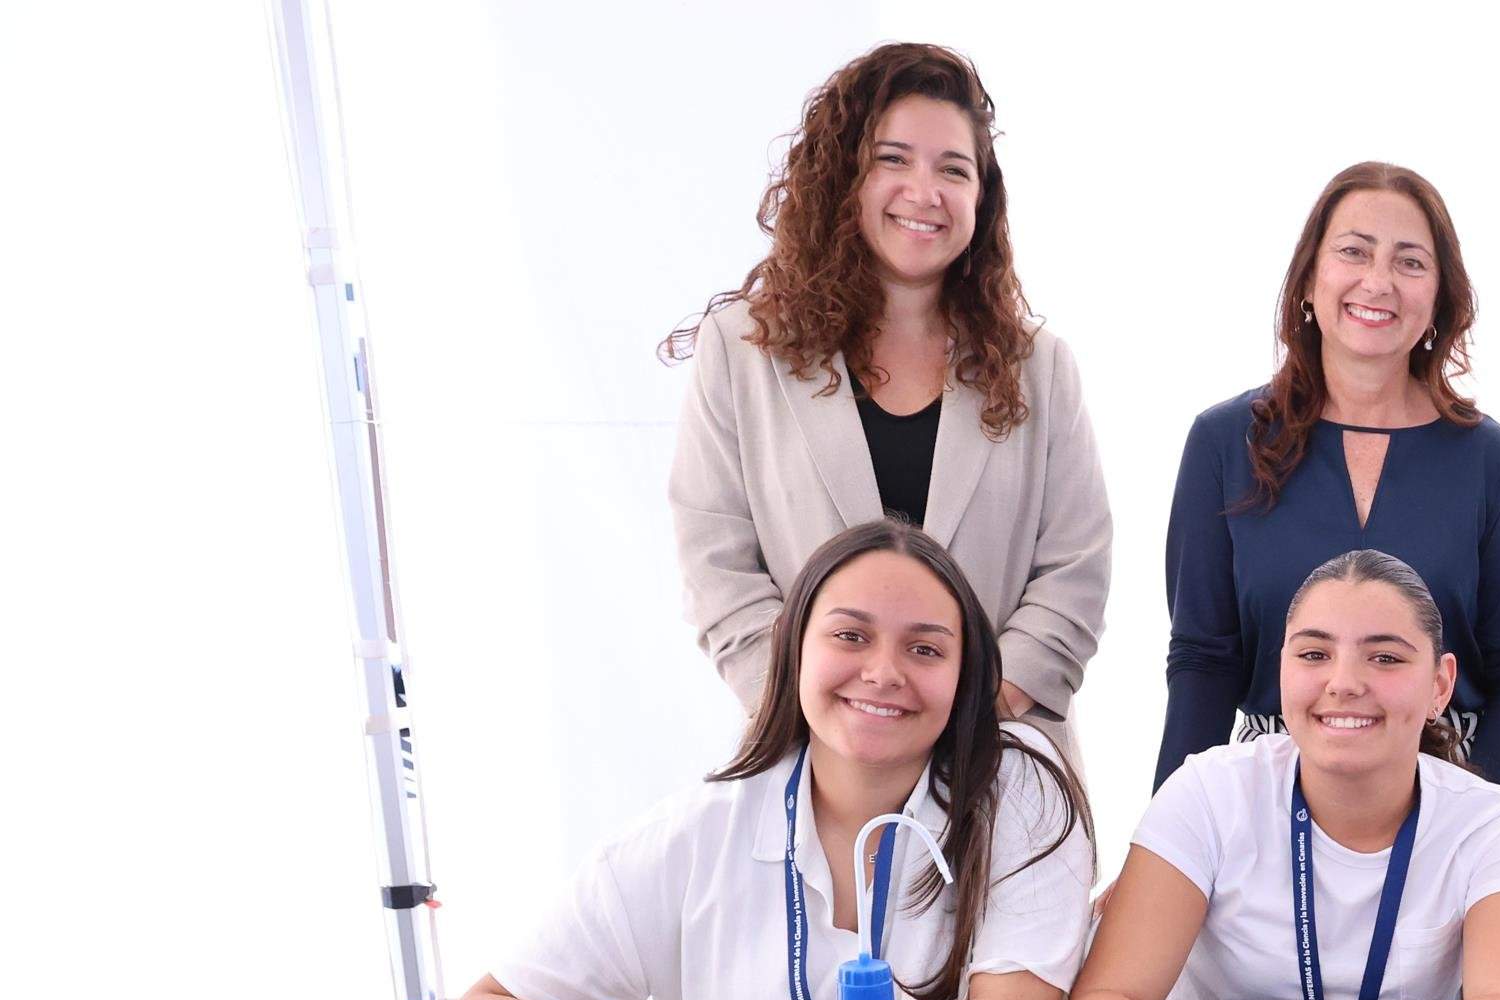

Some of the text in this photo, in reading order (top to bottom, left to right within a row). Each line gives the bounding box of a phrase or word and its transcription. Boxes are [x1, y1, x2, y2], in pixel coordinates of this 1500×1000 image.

[1297, 832, 1306, 861] Canarias
[1300, 862, 1306, 871] en
[1298, 873, 1308, 910] Innovación
[793, 901, 801, 909] la
[793, 915, 802, 940] Ciencia
[1300, 924, 1310, 949] Ciencia
[793, 940, 801, 948] la
[793, 948, 801, 957] de
[1303, 957, 1312, 965] de
